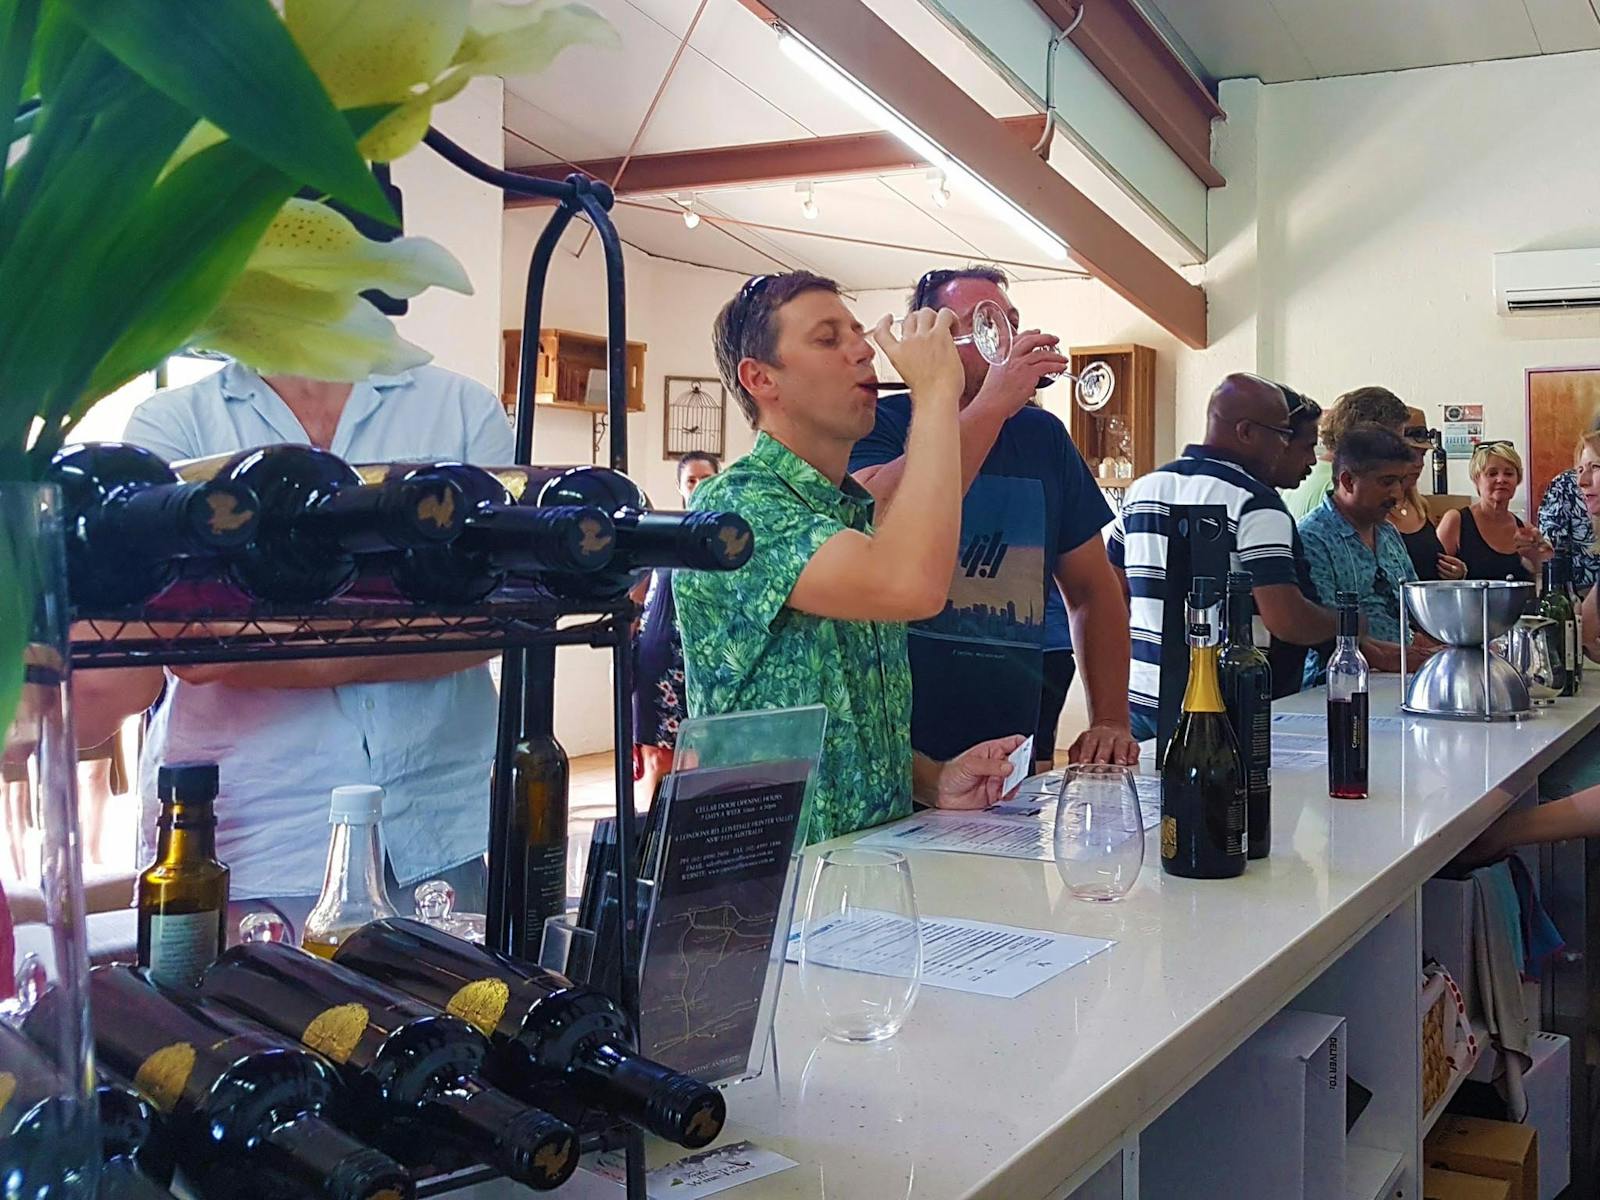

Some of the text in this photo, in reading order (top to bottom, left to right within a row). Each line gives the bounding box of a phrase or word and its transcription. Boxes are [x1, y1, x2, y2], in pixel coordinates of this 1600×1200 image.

[695, 794, 783, 814] CELLAR DOOR OPENING HOURS
[679, 830, 710, 841] LONDONS
[751, 817, 774, 827] HUNTER
[705, 836, 718, 844] NSW
[1329, 1037, 1338, 1073] DELIVER
